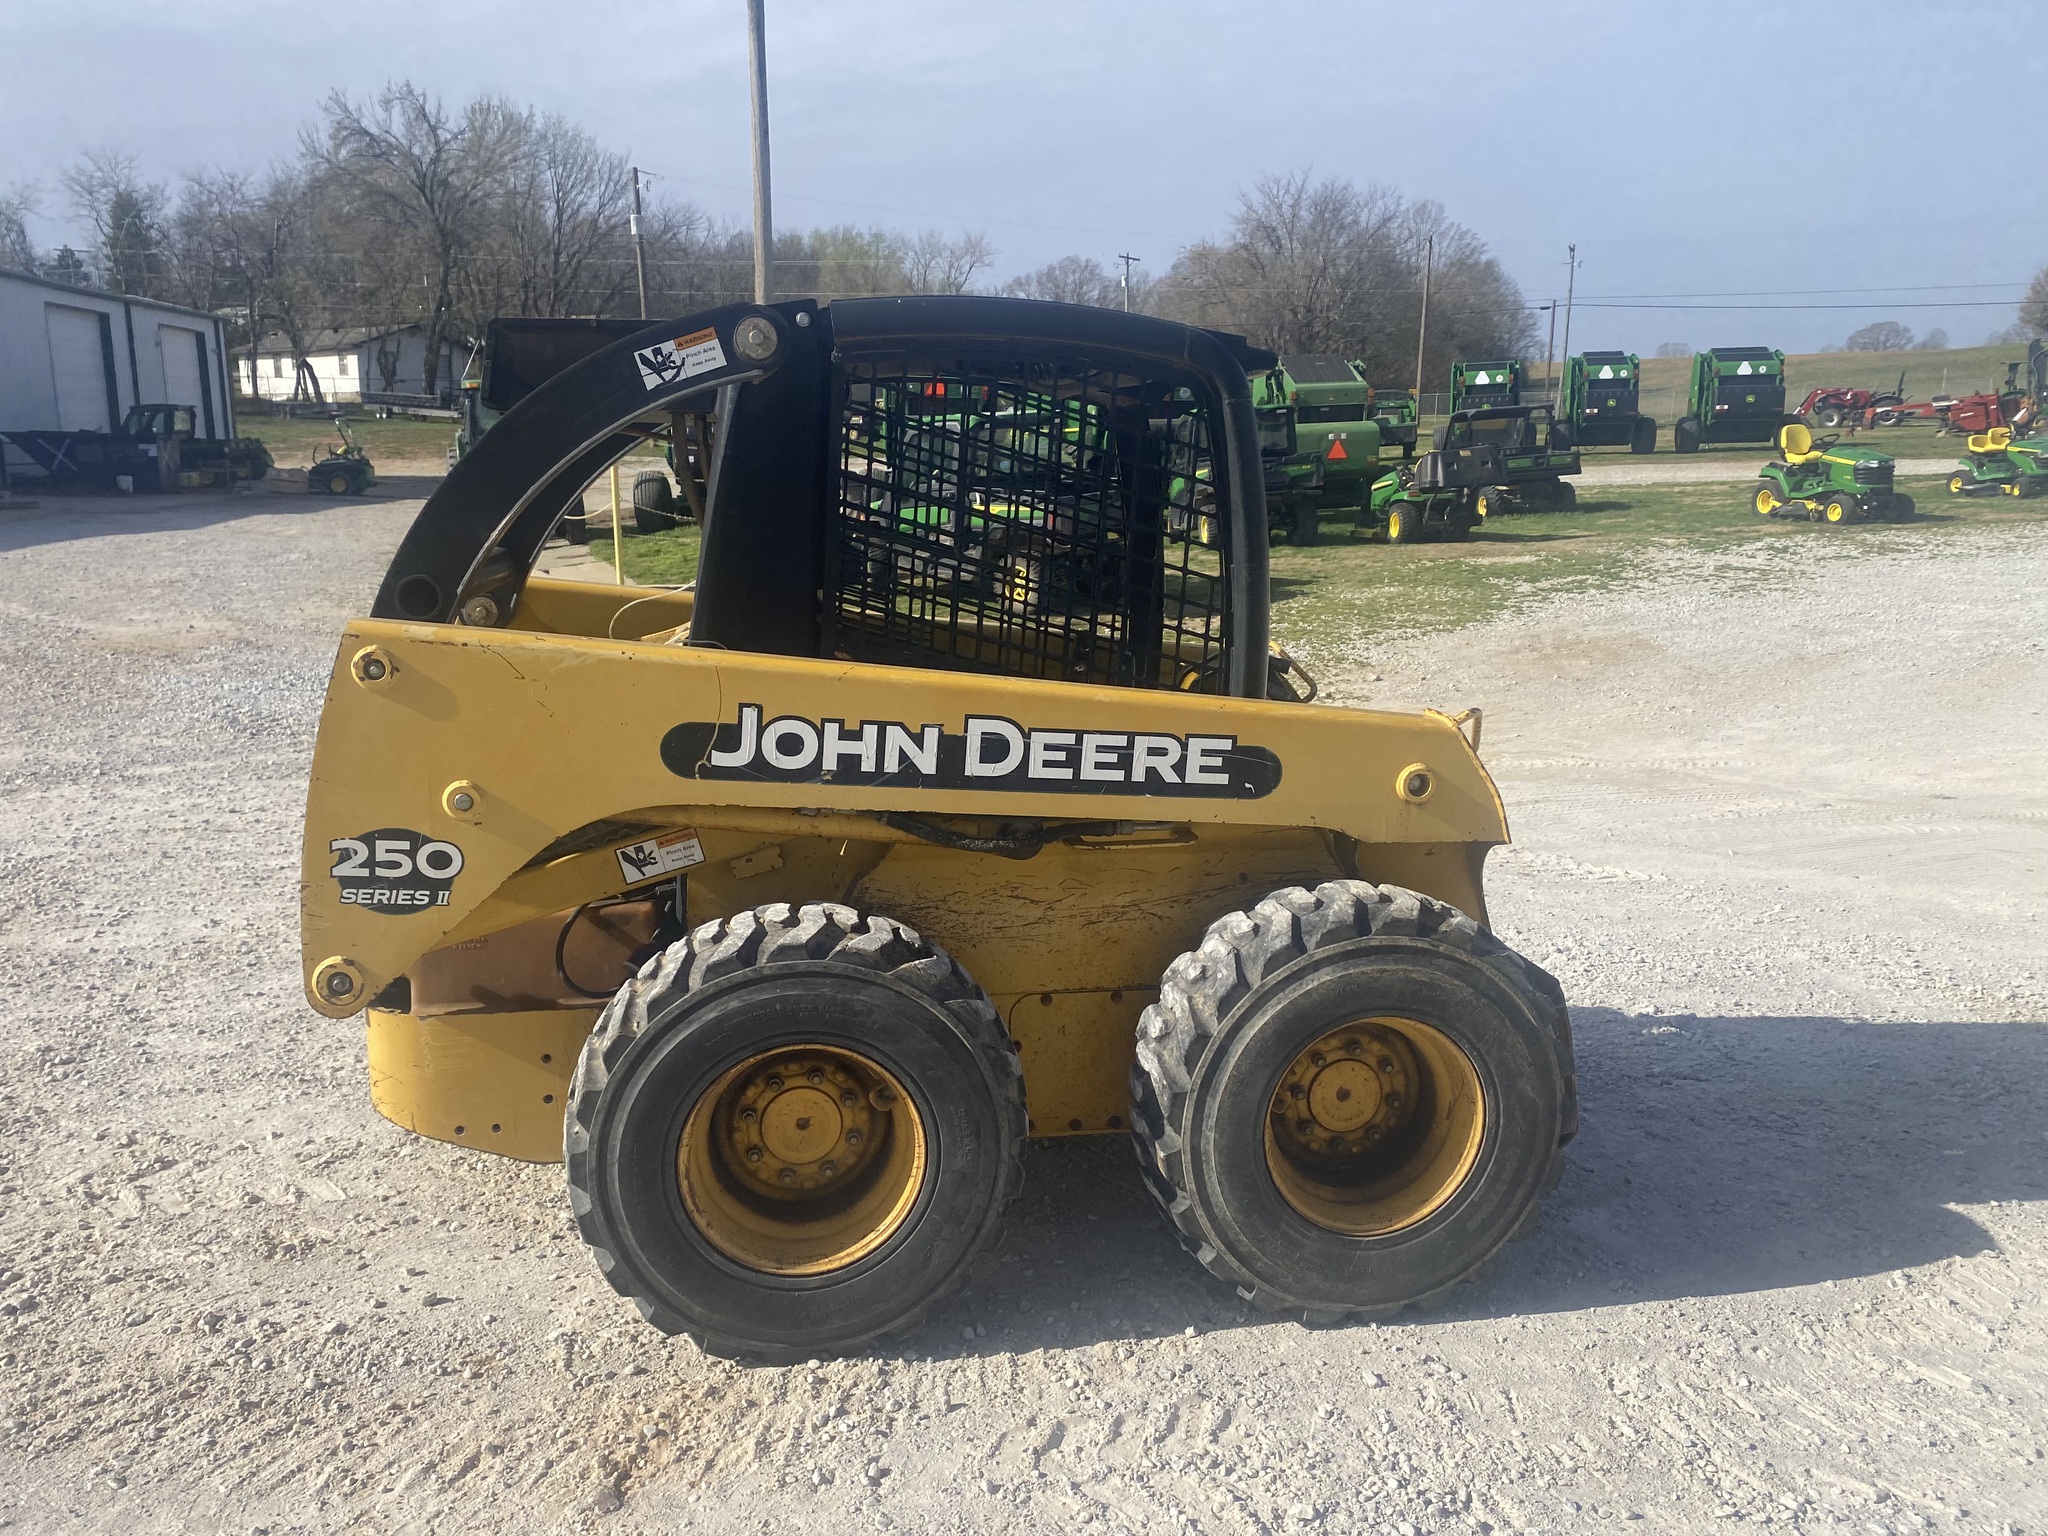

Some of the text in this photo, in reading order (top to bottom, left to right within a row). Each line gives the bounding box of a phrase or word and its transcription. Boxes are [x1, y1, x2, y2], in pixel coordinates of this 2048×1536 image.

[684, 331, 713, 345] WARNING
[686, 346, 716, 359] Pinch Area
[711, 707, 1231, 785] JOHN DEERE
[331, 839, 462, 879] 250
[666, 848, 682, 856] Pinch
[340, 888, 451, 905] SERIES II
